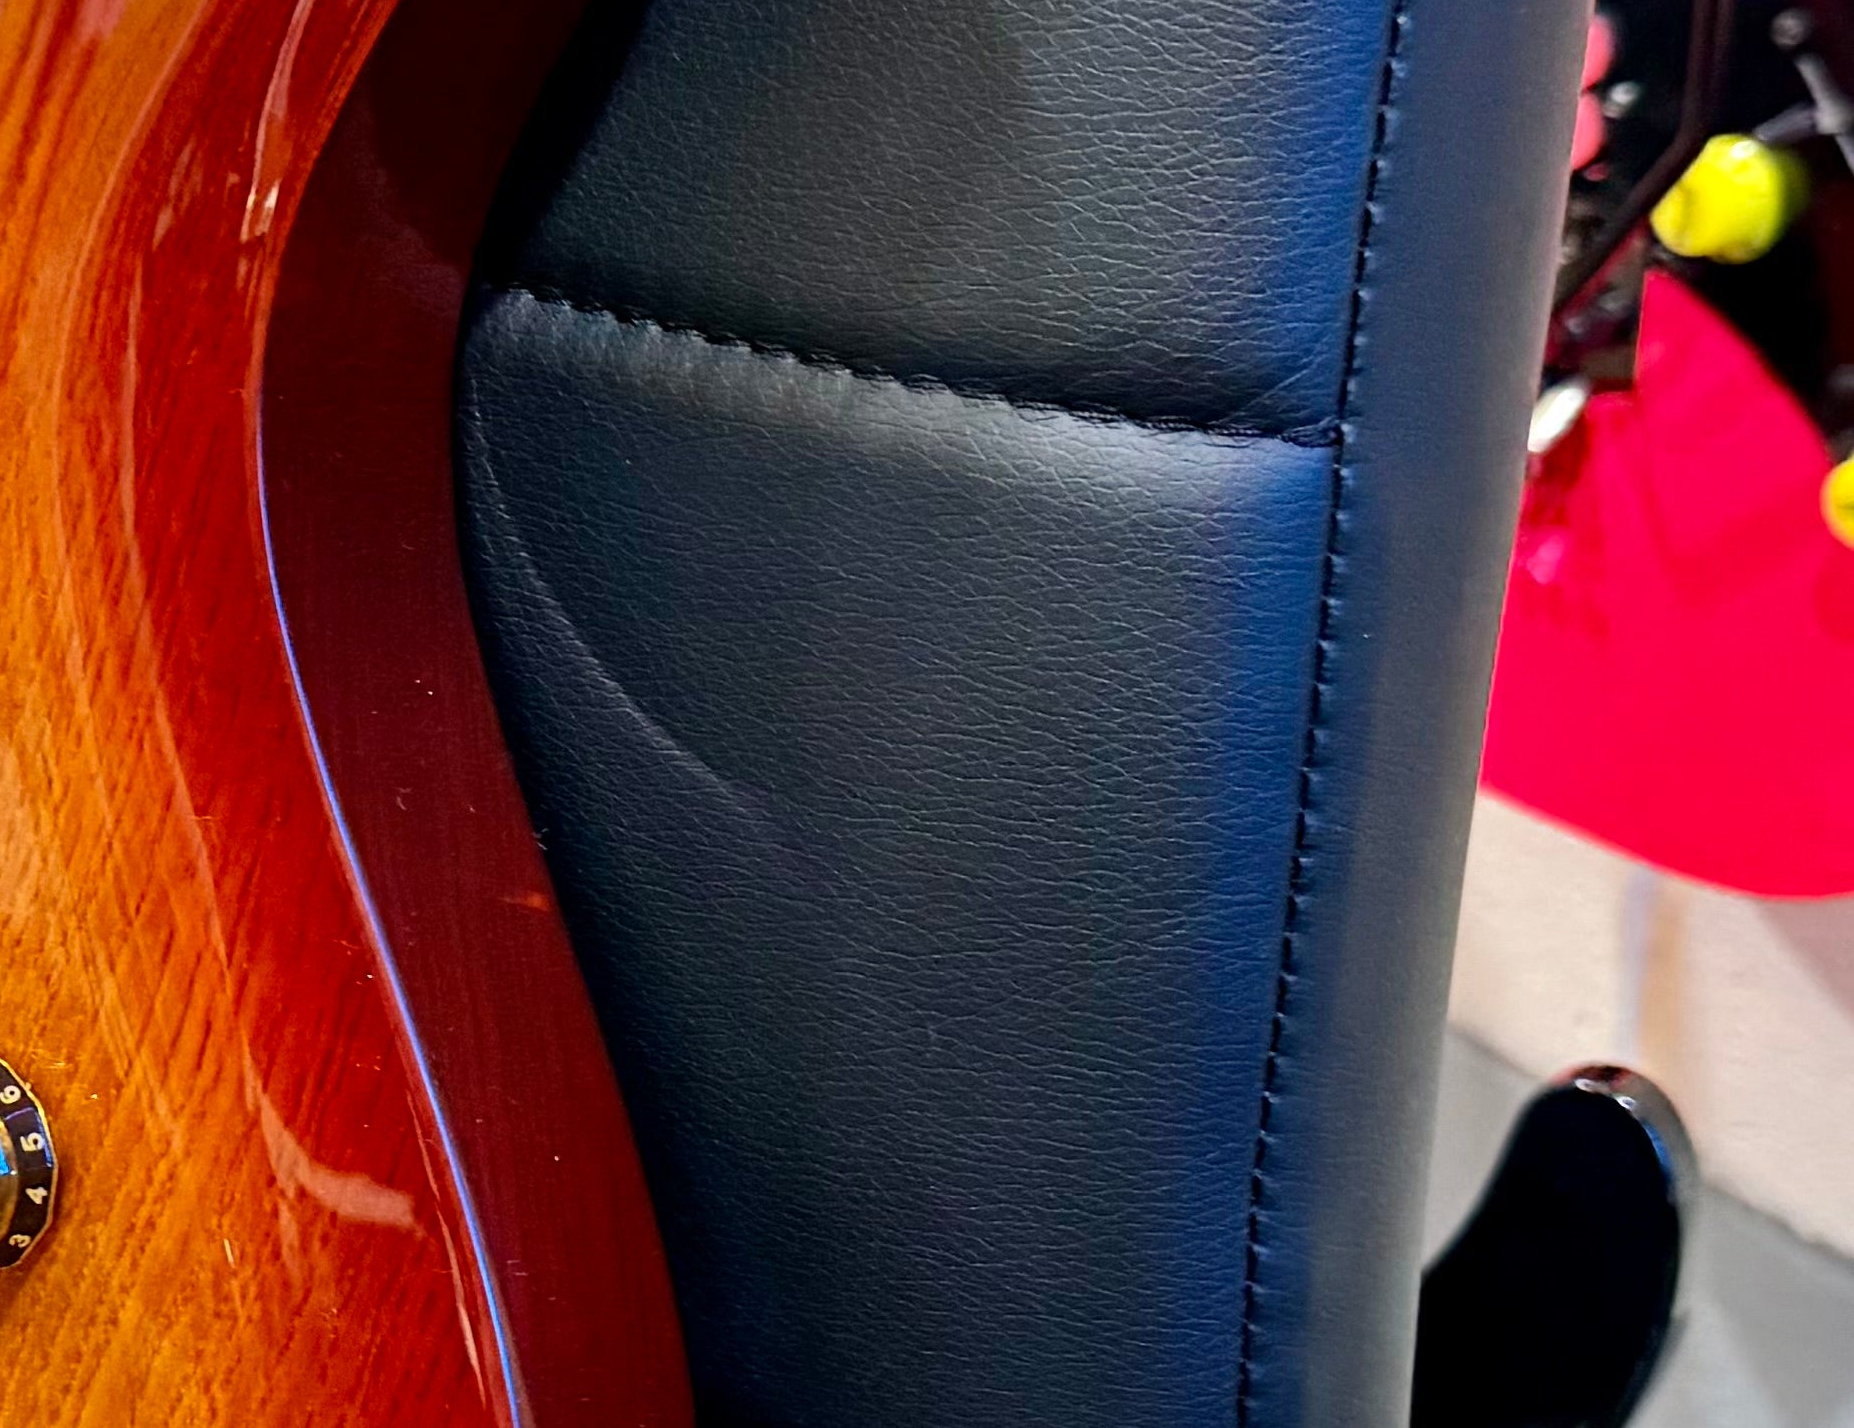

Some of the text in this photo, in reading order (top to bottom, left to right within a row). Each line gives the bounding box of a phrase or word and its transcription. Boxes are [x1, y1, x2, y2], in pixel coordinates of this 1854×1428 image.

[20, 1132, 45, 1152] 5
[25, 1186, 48, 1205] 4
[8, 1233, 32, 1248] 3
